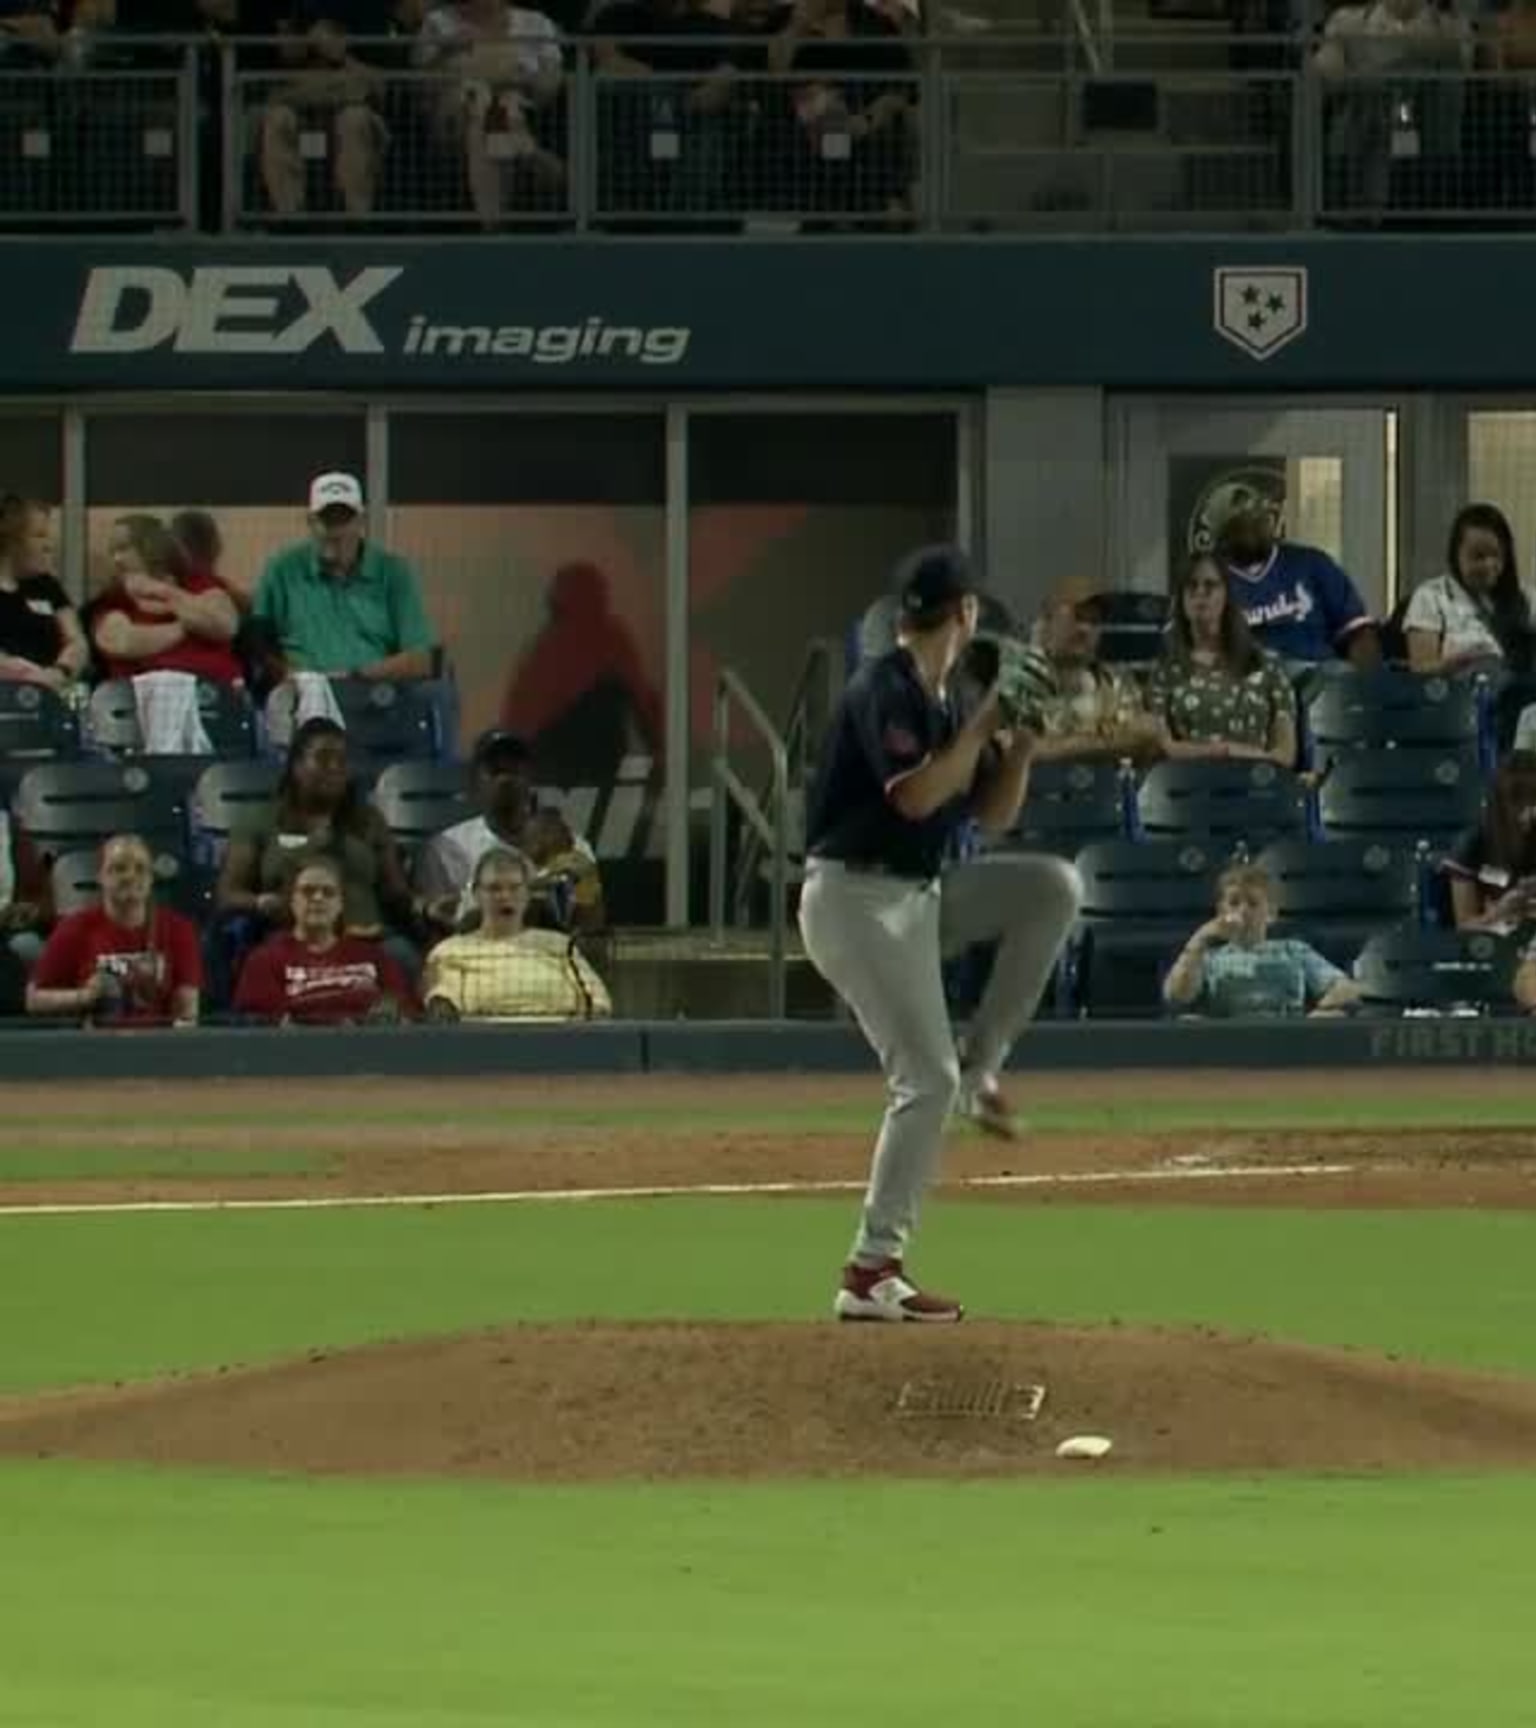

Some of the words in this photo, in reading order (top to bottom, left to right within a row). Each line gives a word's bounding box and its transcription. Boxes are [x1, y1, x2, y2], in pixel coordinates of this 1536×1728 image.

[70, 265, 404, 355] DEX
[403, 315, 691, 364] imaging
[1368, 1027, 1482, 1057] FIRST
